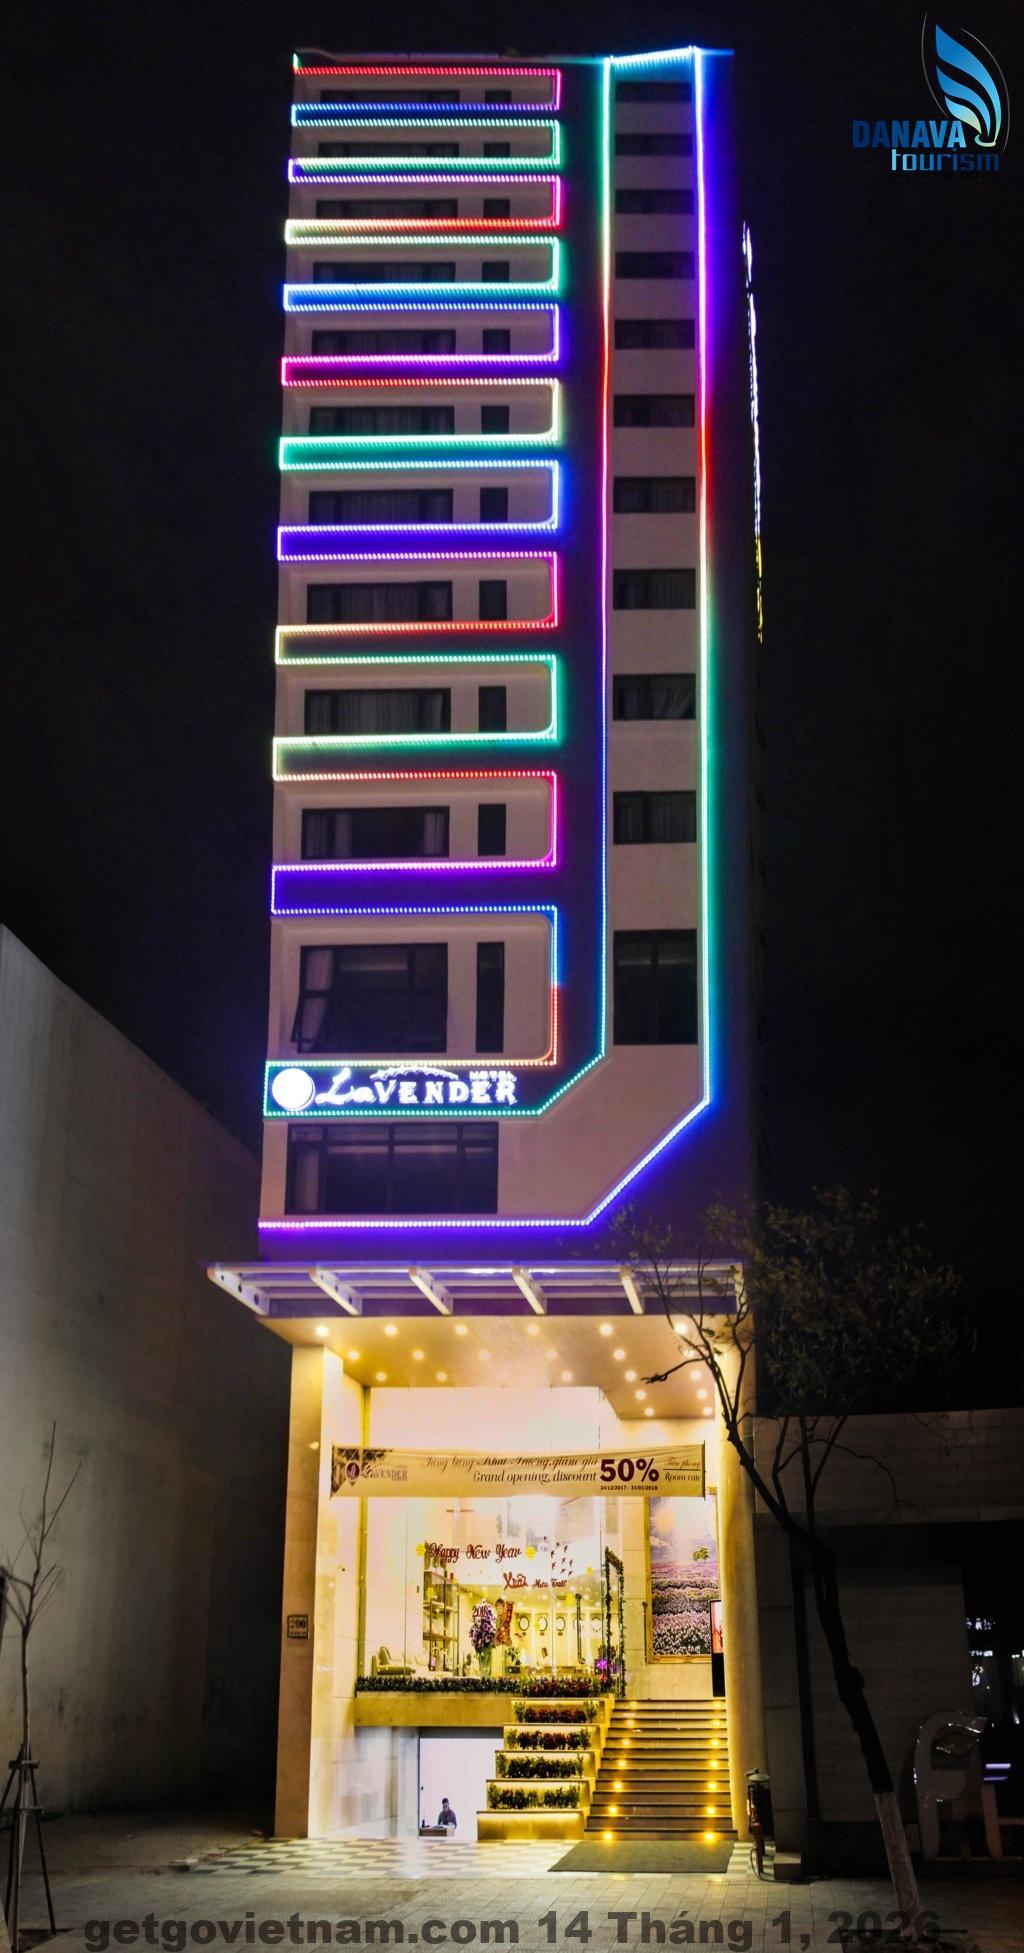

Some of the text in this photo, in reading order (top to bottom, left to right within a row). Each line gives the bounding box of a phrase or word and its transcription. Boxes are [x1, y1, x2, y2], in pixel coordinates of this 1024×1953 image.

[473, 1470, 598, 1485] Grand opening, discount
[600, 1458, 660, 1482] 50%
[664, 1472, 686, 1482] Room
[428, 1542, 522, 1564] Happy New Year
